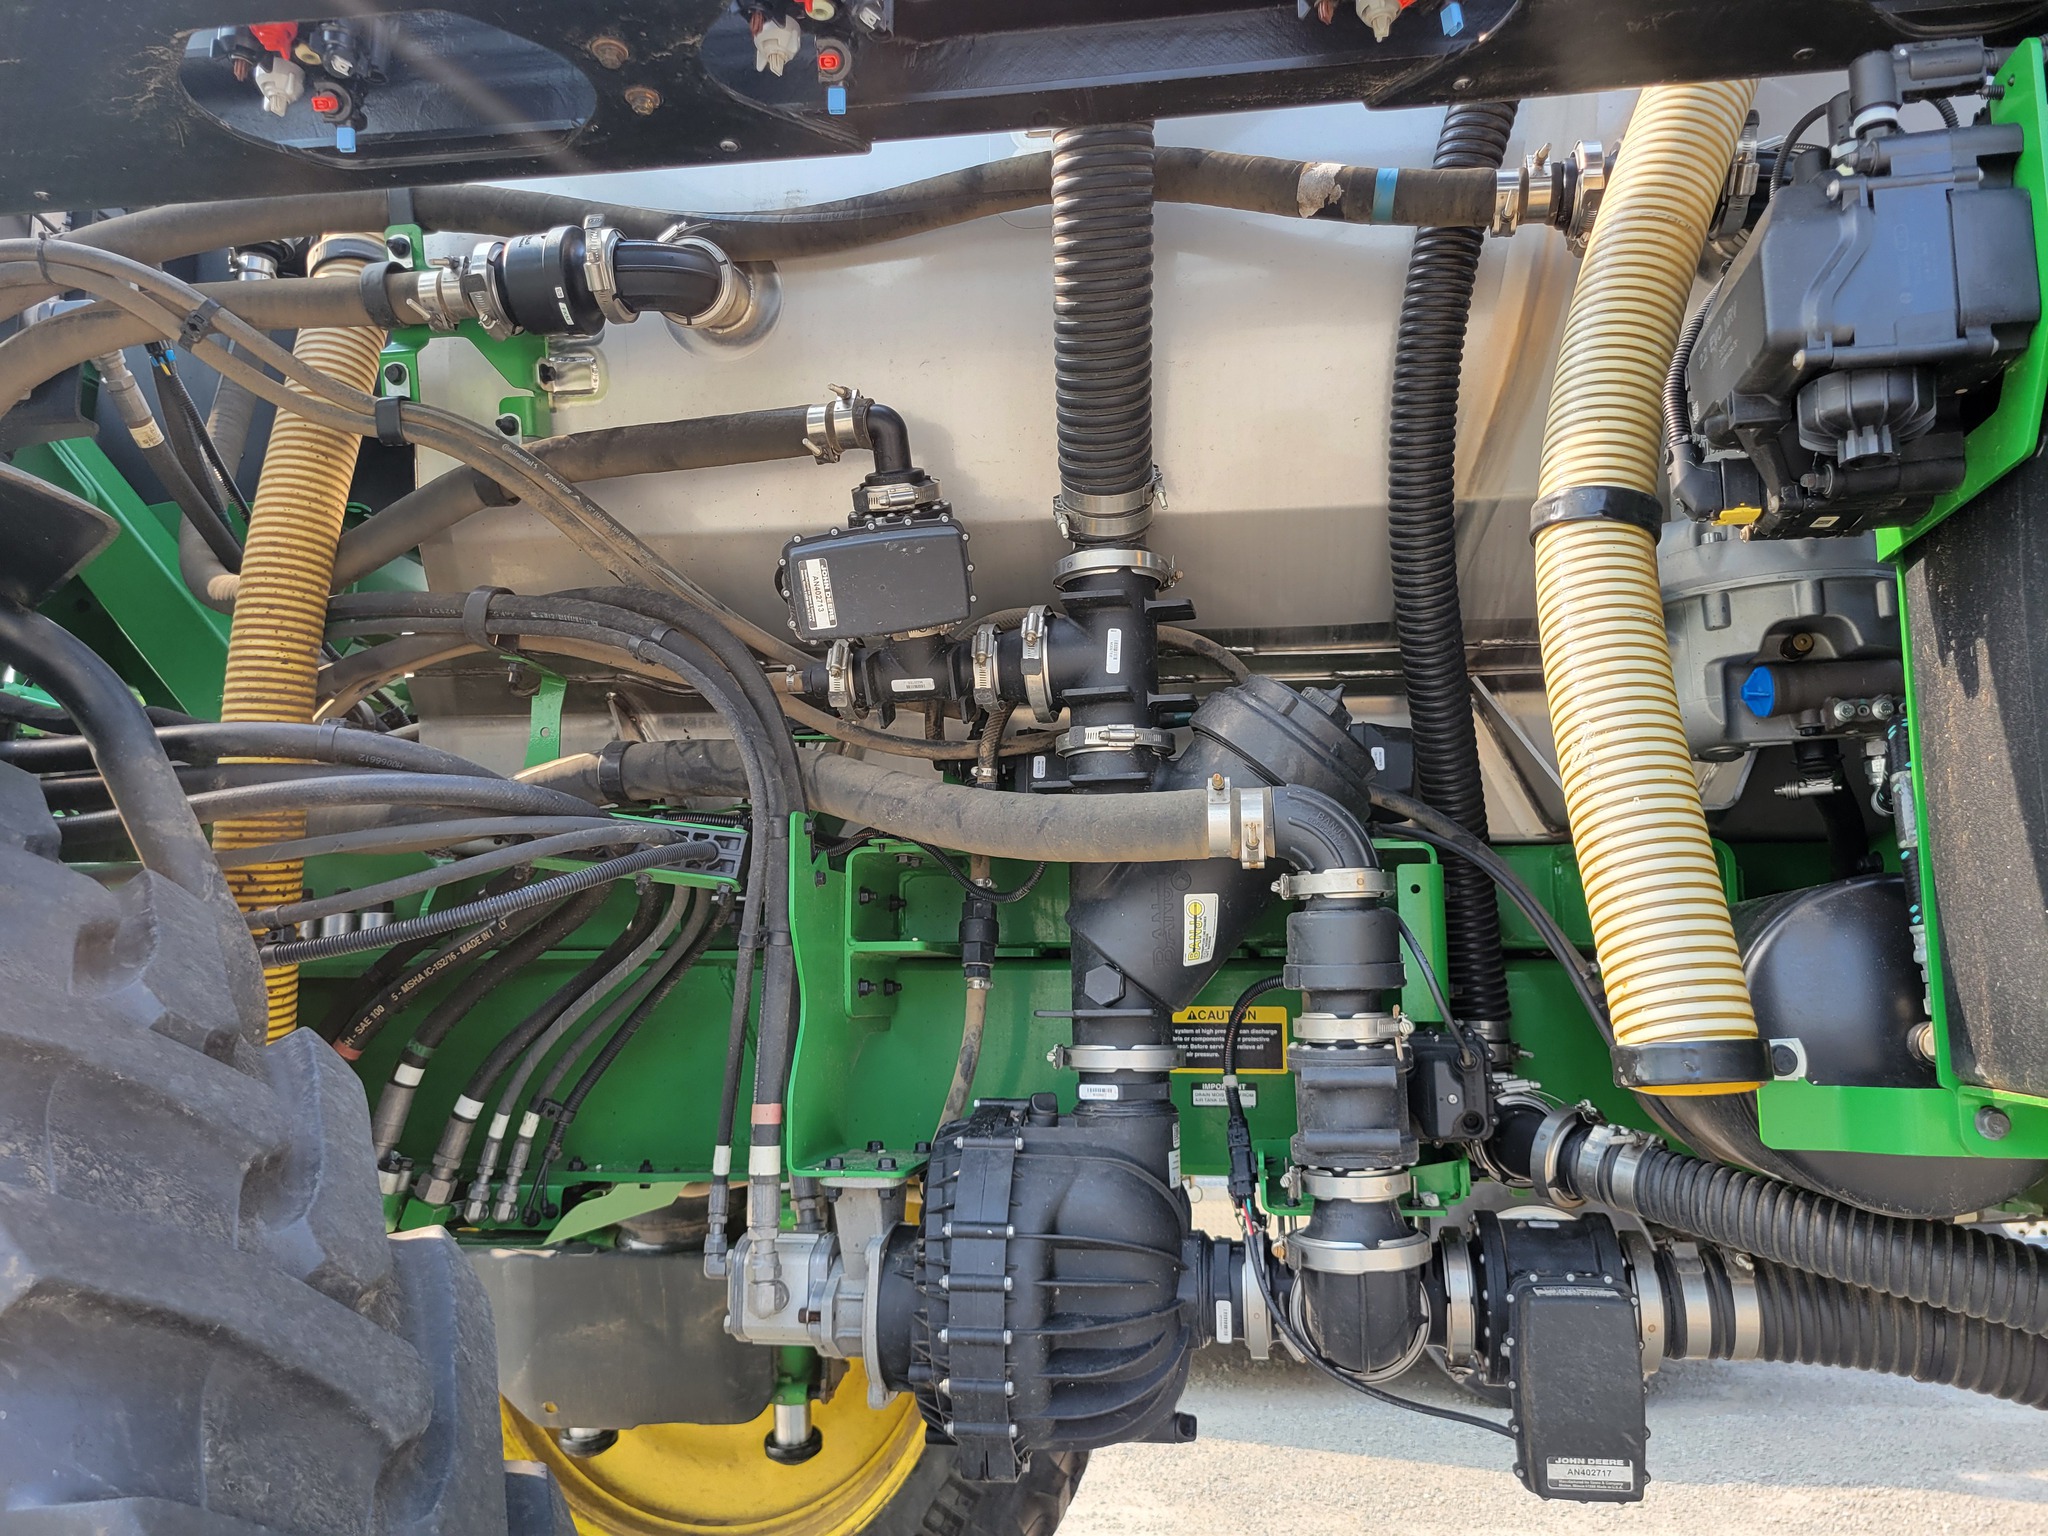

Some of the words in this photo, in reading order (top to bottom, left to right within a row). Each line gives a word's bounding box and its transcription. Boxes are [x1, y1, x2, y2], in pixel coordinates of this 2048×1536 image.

[544, 473, 574, 495] FRONTIER
[821, 564, 831, 590] JOHN
[812, 575, 825, 613] AN402713
[825, 591, 836, 621] DEERE
[1317, 811, 1347, 840] BANJO
[354, 1015, 373, 1035] SAE
[400, 973, 425, 993] MSHA
[424, 951, 457, 977] IC-152/16
[460, 936, 483, 954] MADE
[1555, 1457, 1585, 1465] JOHN
[1587, 1458, 1624, 1466] DEERE
[1567, 1468, 1612, 1477] AN402717
